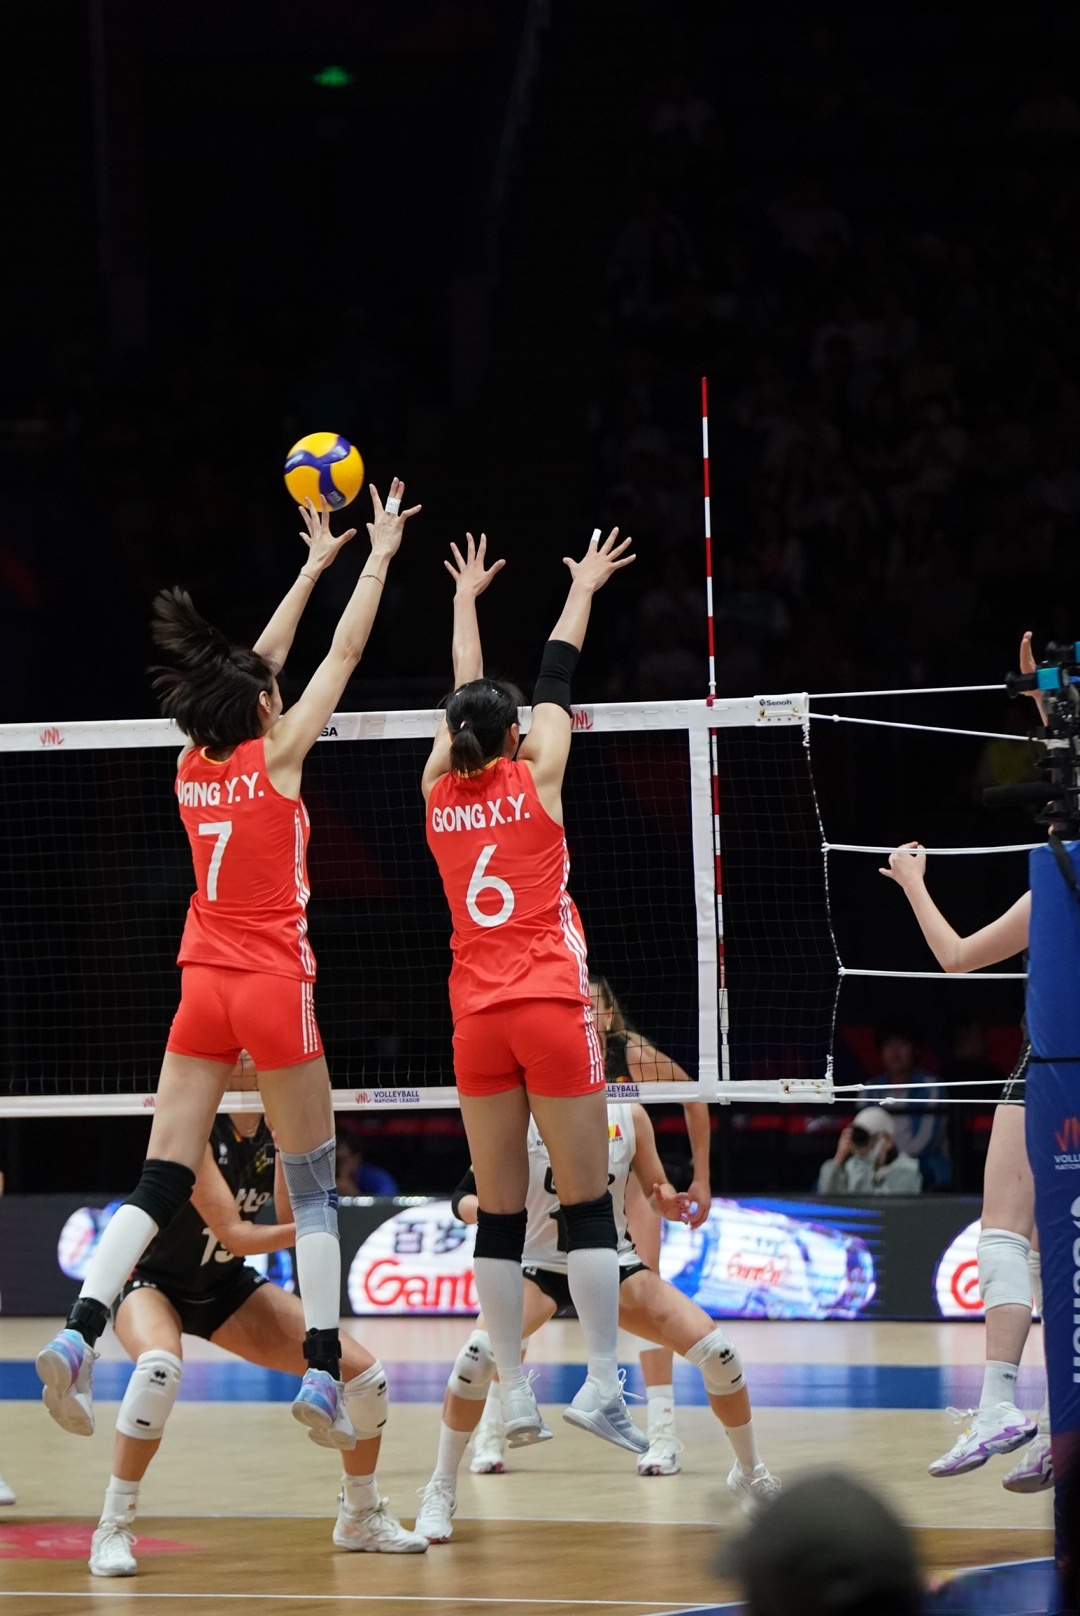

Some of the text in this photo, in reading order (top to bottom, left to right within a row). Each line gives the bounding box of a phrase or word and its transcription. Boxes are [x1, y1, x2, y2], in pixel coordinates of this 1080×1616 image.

[432, 793, 530, 833] GONG X.Y.
[198, 821, 232, 902] 7
[466, 844, 515, 928] 6
[374, 1090, 419, 1098] VOLLEYBALL
